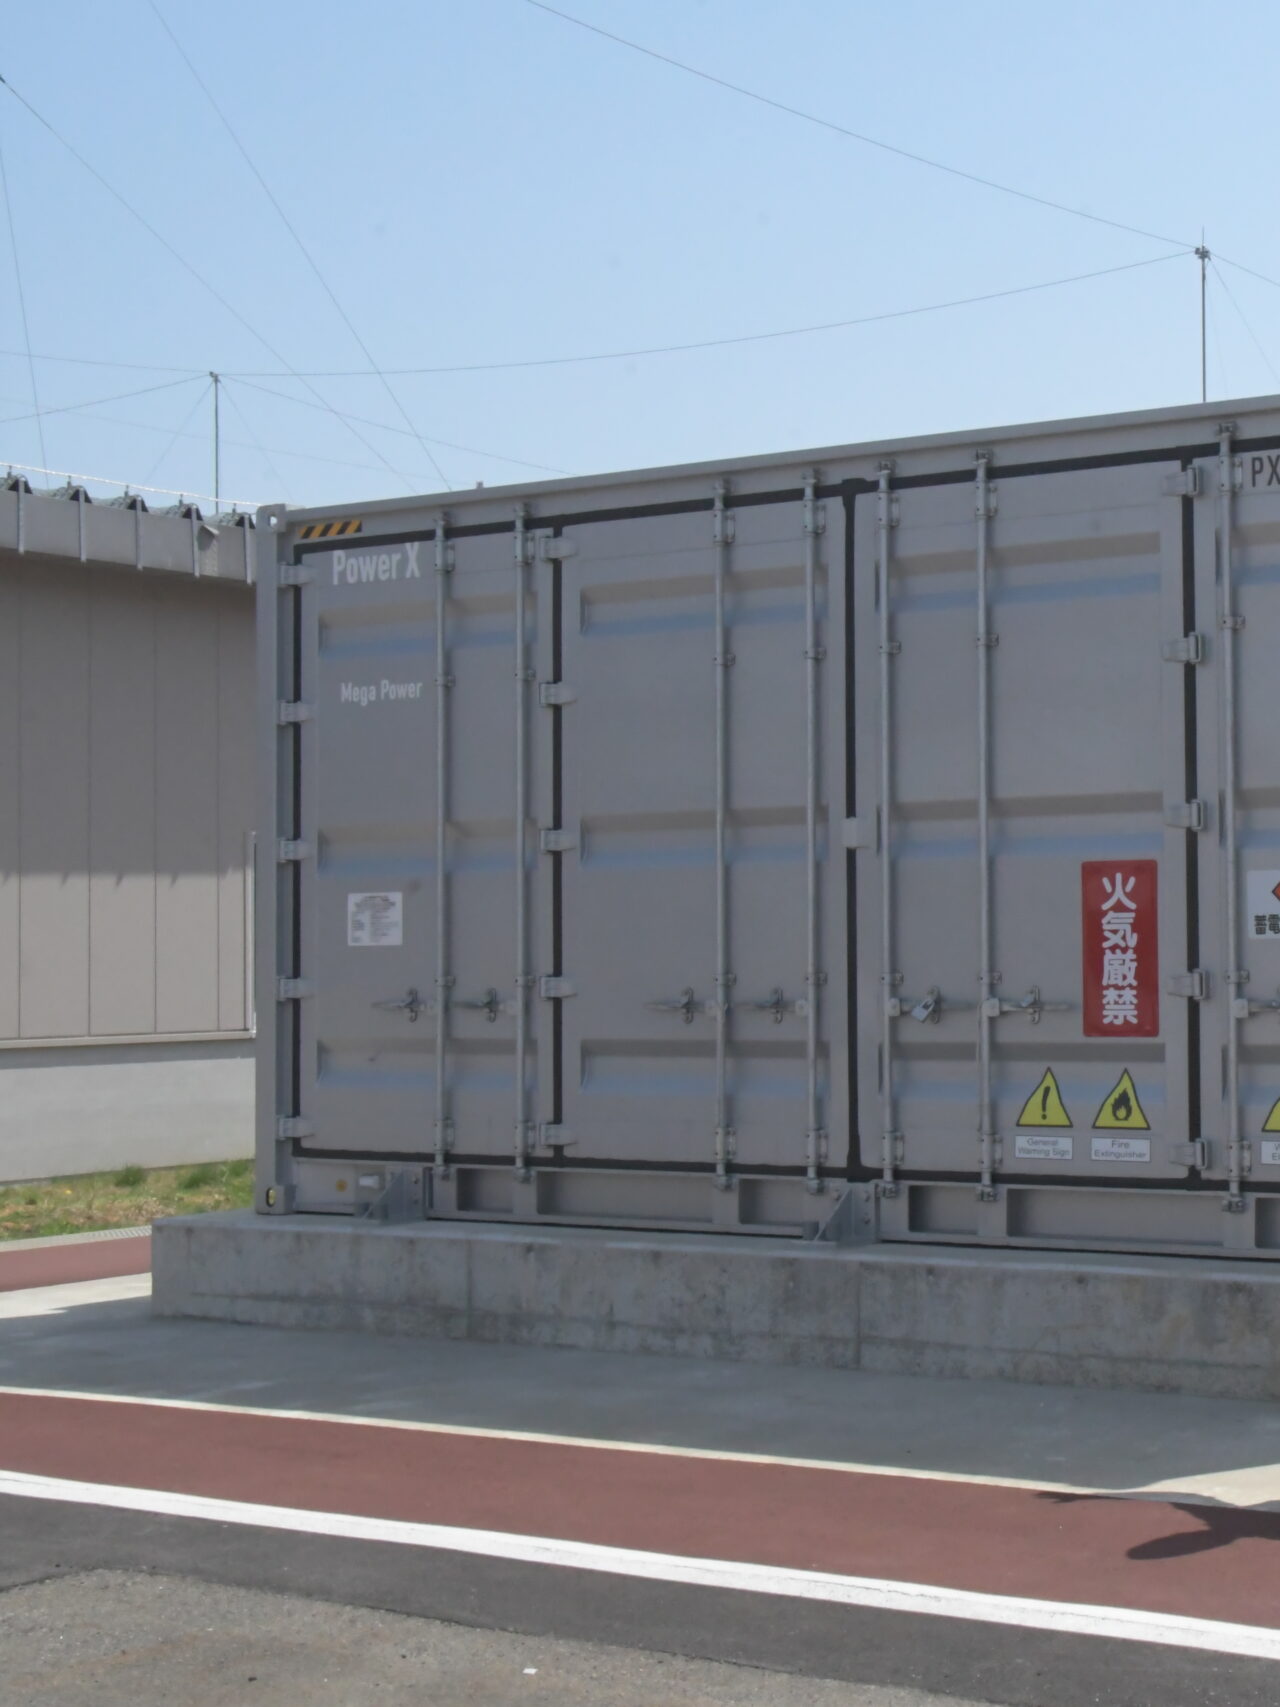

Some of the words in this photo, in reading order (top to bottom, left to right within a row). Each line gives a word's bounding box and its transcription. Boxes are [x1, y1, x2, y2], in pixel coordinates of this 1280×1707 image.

[333, 549, 401, 586] Power
[340, 682, 376, 706] Mega
[380, 679, 423, 701] Power
[1101, 872, 1138, 1025] 火気厳禁
[1017, 1146, 1050, 1157] Warning
[1094, 1149, 1147, 1159] Extinguisher
[1111, 1140, 1130, 1149] Fire
